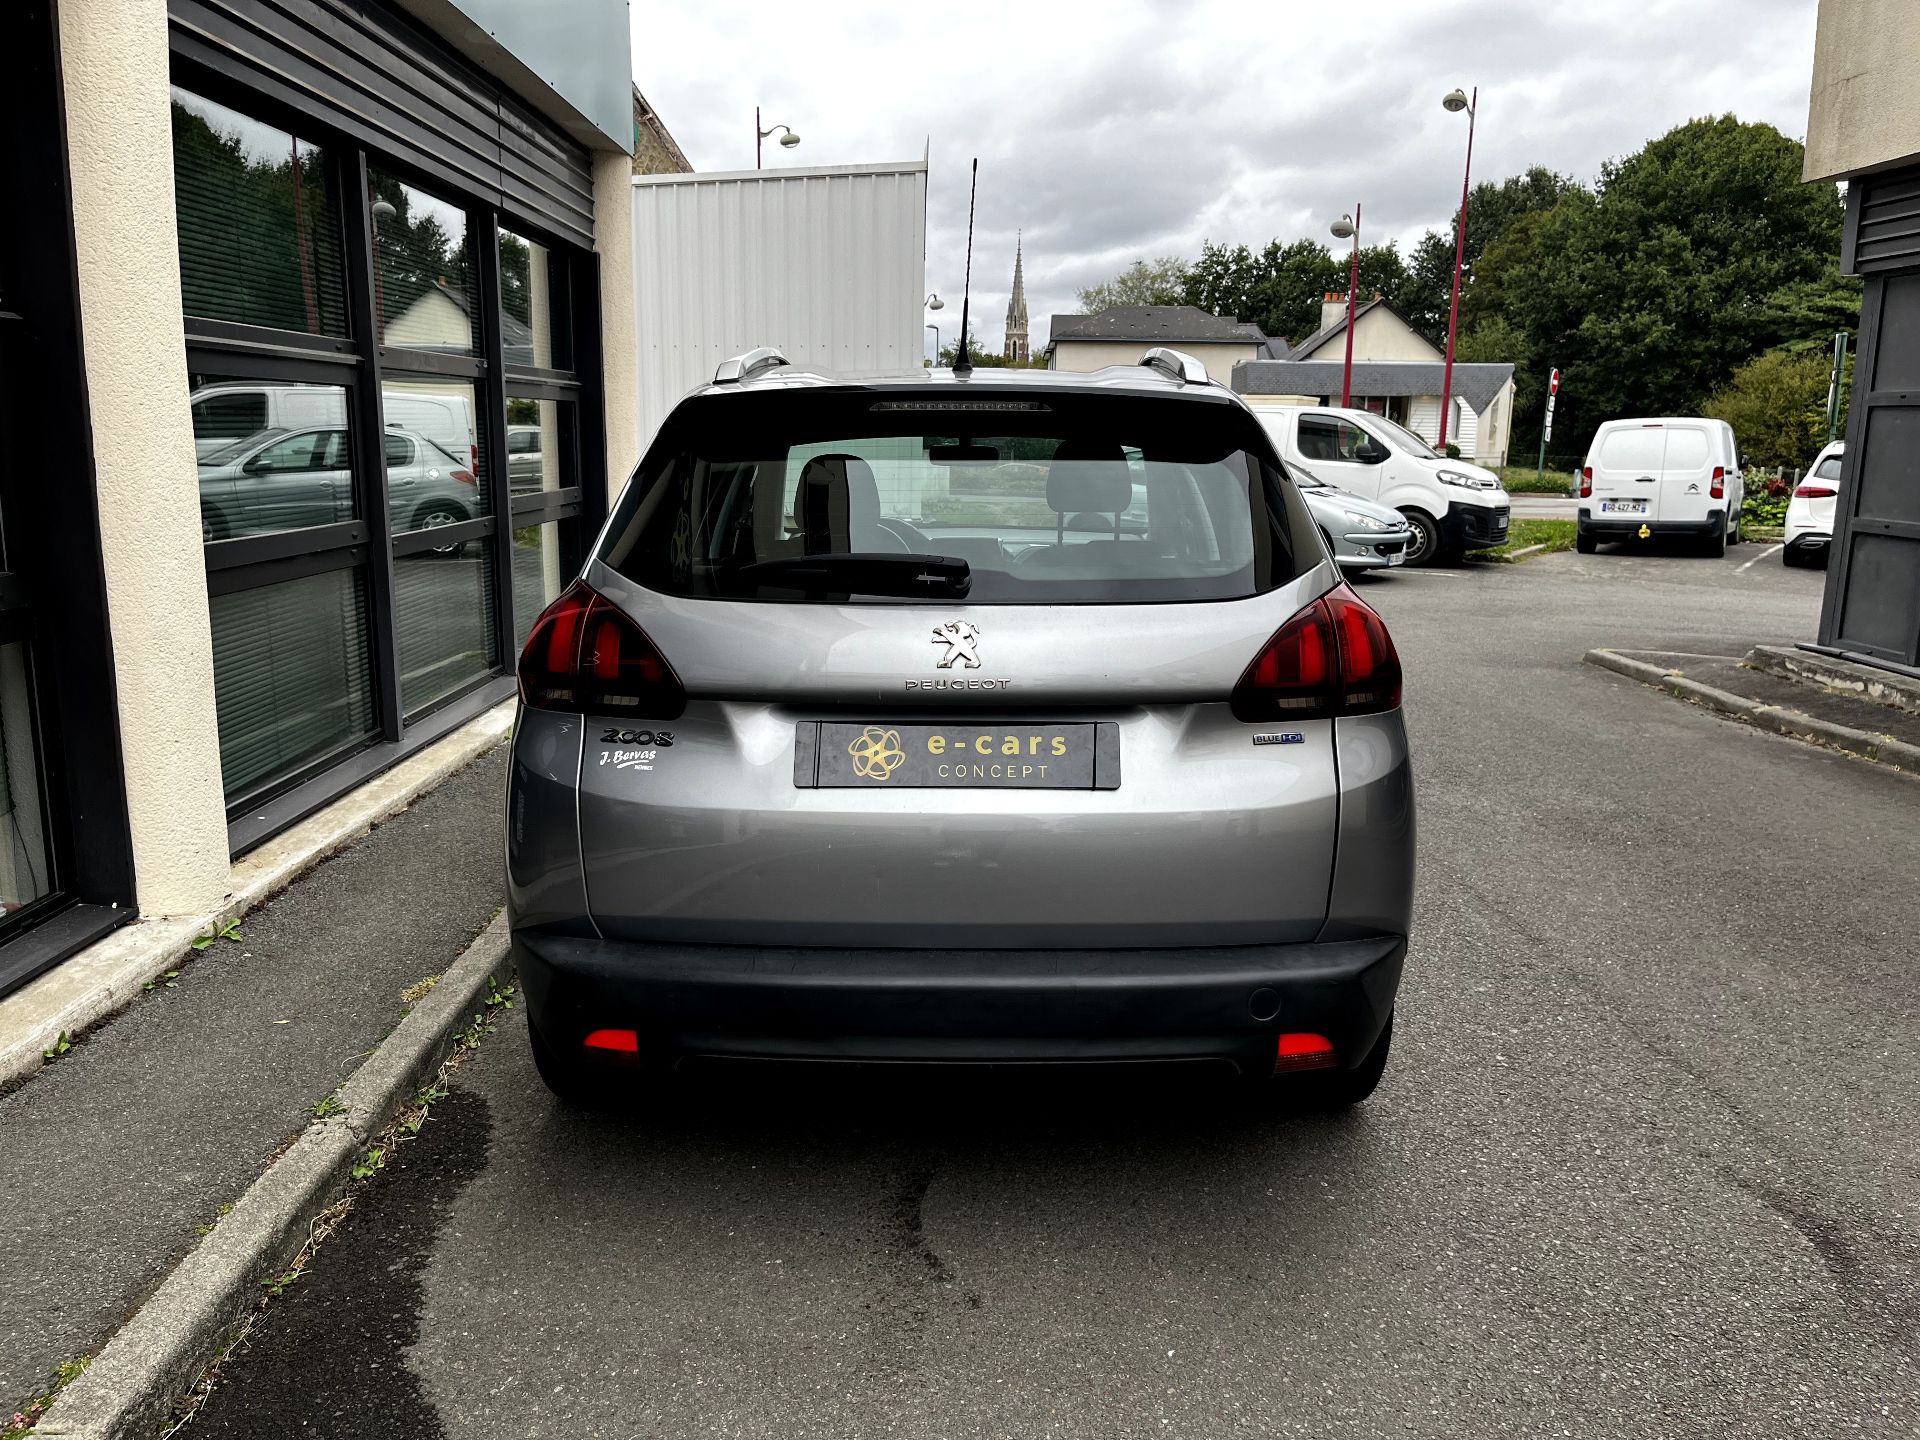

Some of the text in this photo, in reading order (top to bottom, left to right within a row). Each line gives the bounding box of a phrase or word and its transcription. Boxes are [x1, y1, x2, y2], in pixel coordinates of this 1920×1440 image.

[905, 678, 1011, 690] PEUGEOT
[600, 728, 675, 747] 2008
[928, 735, 1067, 755] e-cars
[938, 764, 1048, 778] CONCEPT
